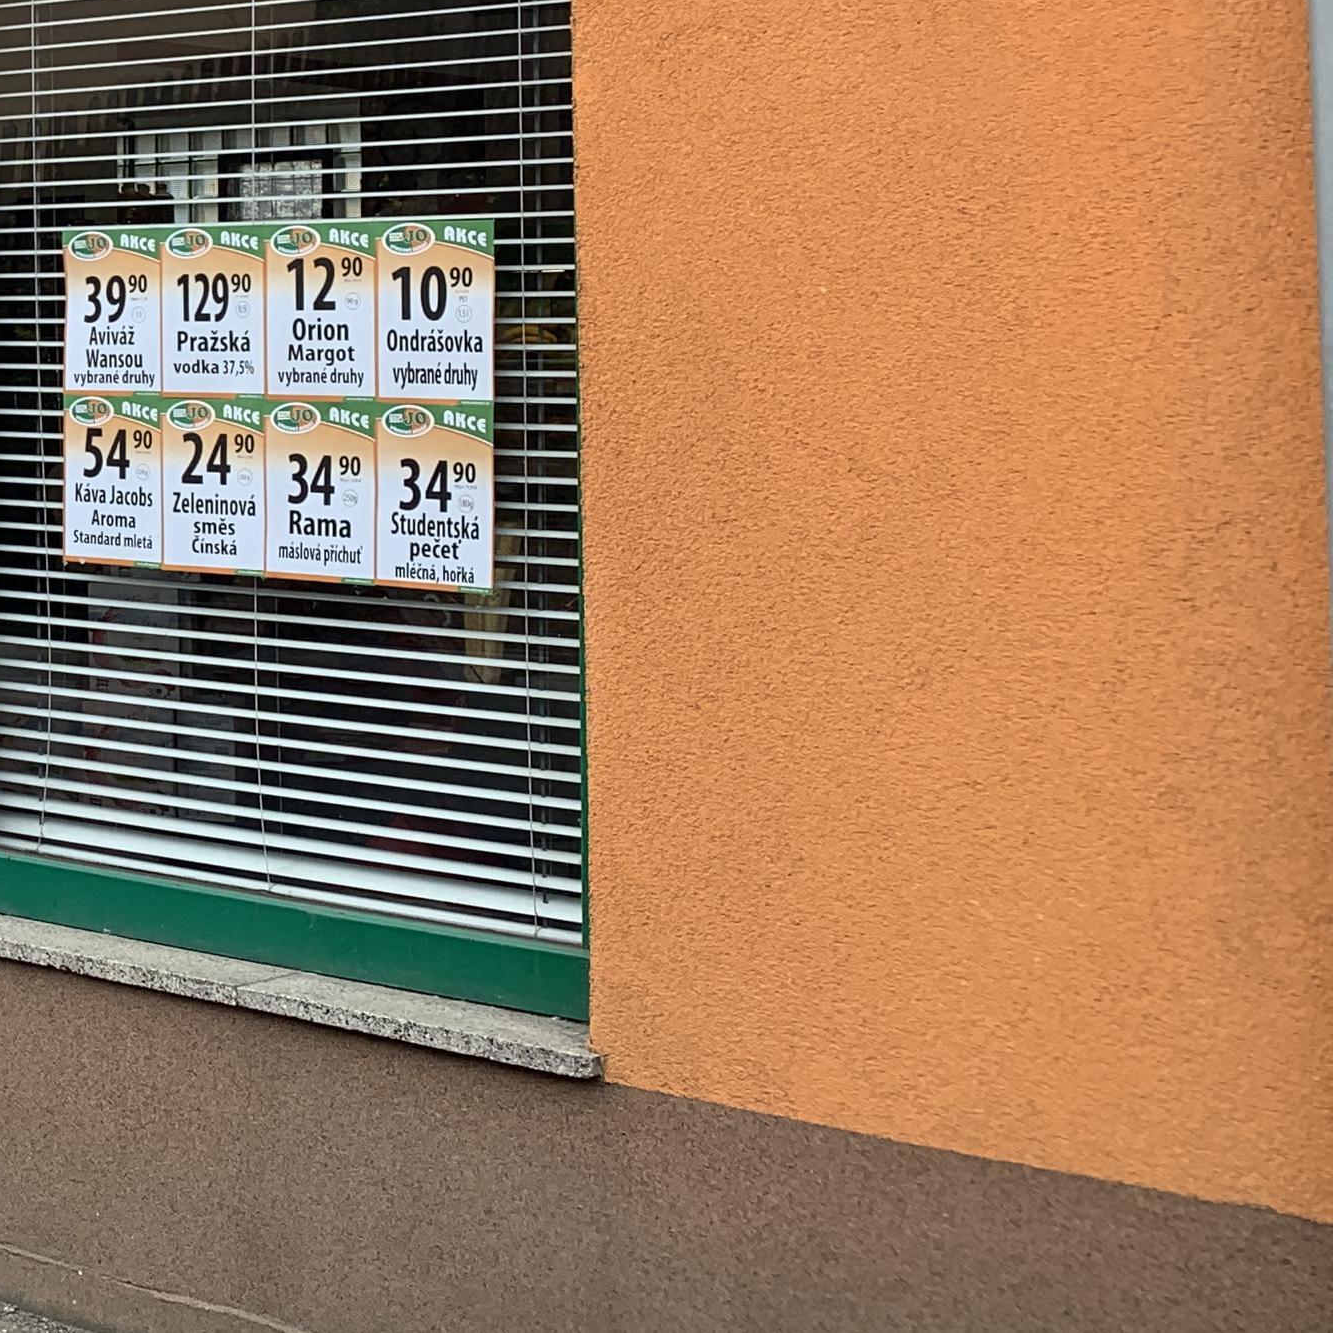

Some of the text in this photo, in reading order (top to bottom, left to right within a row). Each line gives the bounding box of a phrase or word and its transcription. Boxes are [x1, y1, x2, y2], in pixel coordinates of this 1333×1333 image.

[120, 233, 155, 252] AKCE
[220, 230, 258, 250] AKCE
[329, 228, 369, 248] AKCE
[444, 225, 487, 247] AKCE
[287, 257, 363, 311] 12 90
[391, 266, 473, 321] 10 90
[84, 274, 147, 323] 39 90
[177, 272, 251, 322] 129 90
[89, 326, 134, 345] Aviváž
[292, 317, 349, 341] Orion
[177, 330, 250, 352] Pražská
[387, 328, 483, 353] Ondrášovka
[86, 349, 143, 368] Wansou
[287, 344, 355, 366] Margot
[74, 370, 155, 388] vybrané druhy
[173, 359, 255, 377] vodka 37,5%
[278, 367, 364, 388] vybrané druhy
[393, 361, 478, 391] vybrané druhy
[121, 401, 158, 422] AKCE
[223, 404, 260, 425] AKCE
[329, 406, 370, 430] AKCE
[443, 409, 487, 434] AKCE
[83, 427, 153, 480] 54 90
[181, 432, 255, 486] 24 90
[288, 453, 361, 506] 34 90
[399, 458, 476, 513] 34 90
[75, 482, 153, 507] Káva Jacobs
[173, 492, 256, 516] Zeleninová
[91, 509, 136, 528] Aroma
[194, 518, 235, 536] směs
[289, 510, 351, 538] Rama
[391, 511, 479, 540] Studentská
[73, 529, 153, 549] Standard mletá
[191, 535, 237, 556] Čínská
[409, 539, 462, 561] pečeť
[278, 541, 363, 566] máslová příchuť
[395, 562, 439, 583] mléčná,
[442, 565, 474, 583] hořká
